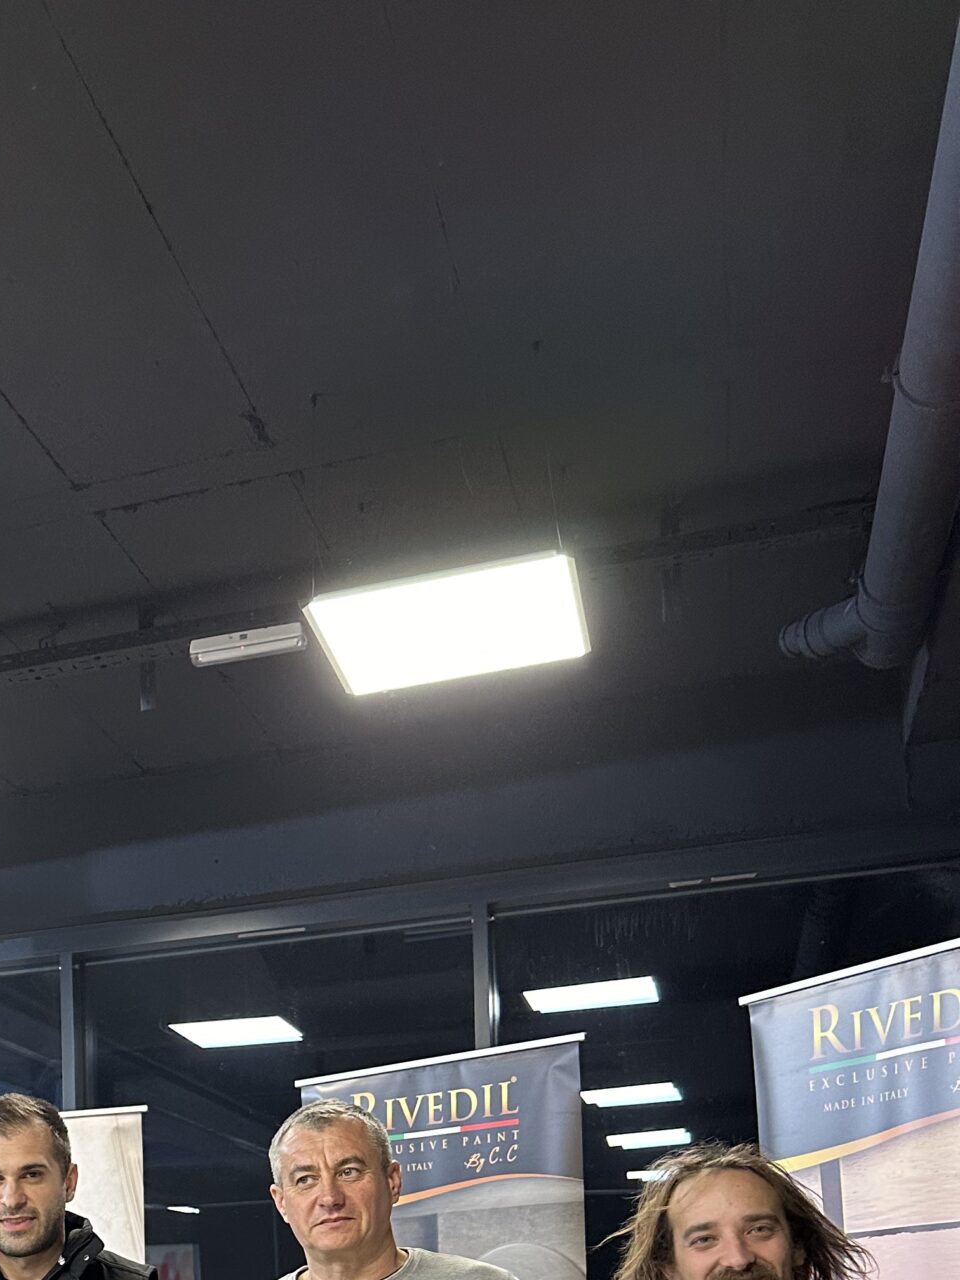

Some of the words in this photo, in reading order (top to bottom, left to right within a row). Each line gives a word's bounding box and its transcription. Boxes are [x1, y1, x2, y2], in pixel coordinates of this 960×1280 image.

[808, 988, 960, 1061] RIVED
[809, 1057, 928, 1091] EXCLUSIVE
[350, 1080, 520, 1131] RIVEDIL
[823, 1098, 856, 1112] MADE
[862, 1095, 874, 1106] IN
[880, 1088, 909, 1102] ITALY
[395, 1138, 448, 1155] USIVE
[462, 1130, 520, 1146] PAINT
[407, 1162, 433, 1172] ITALY
